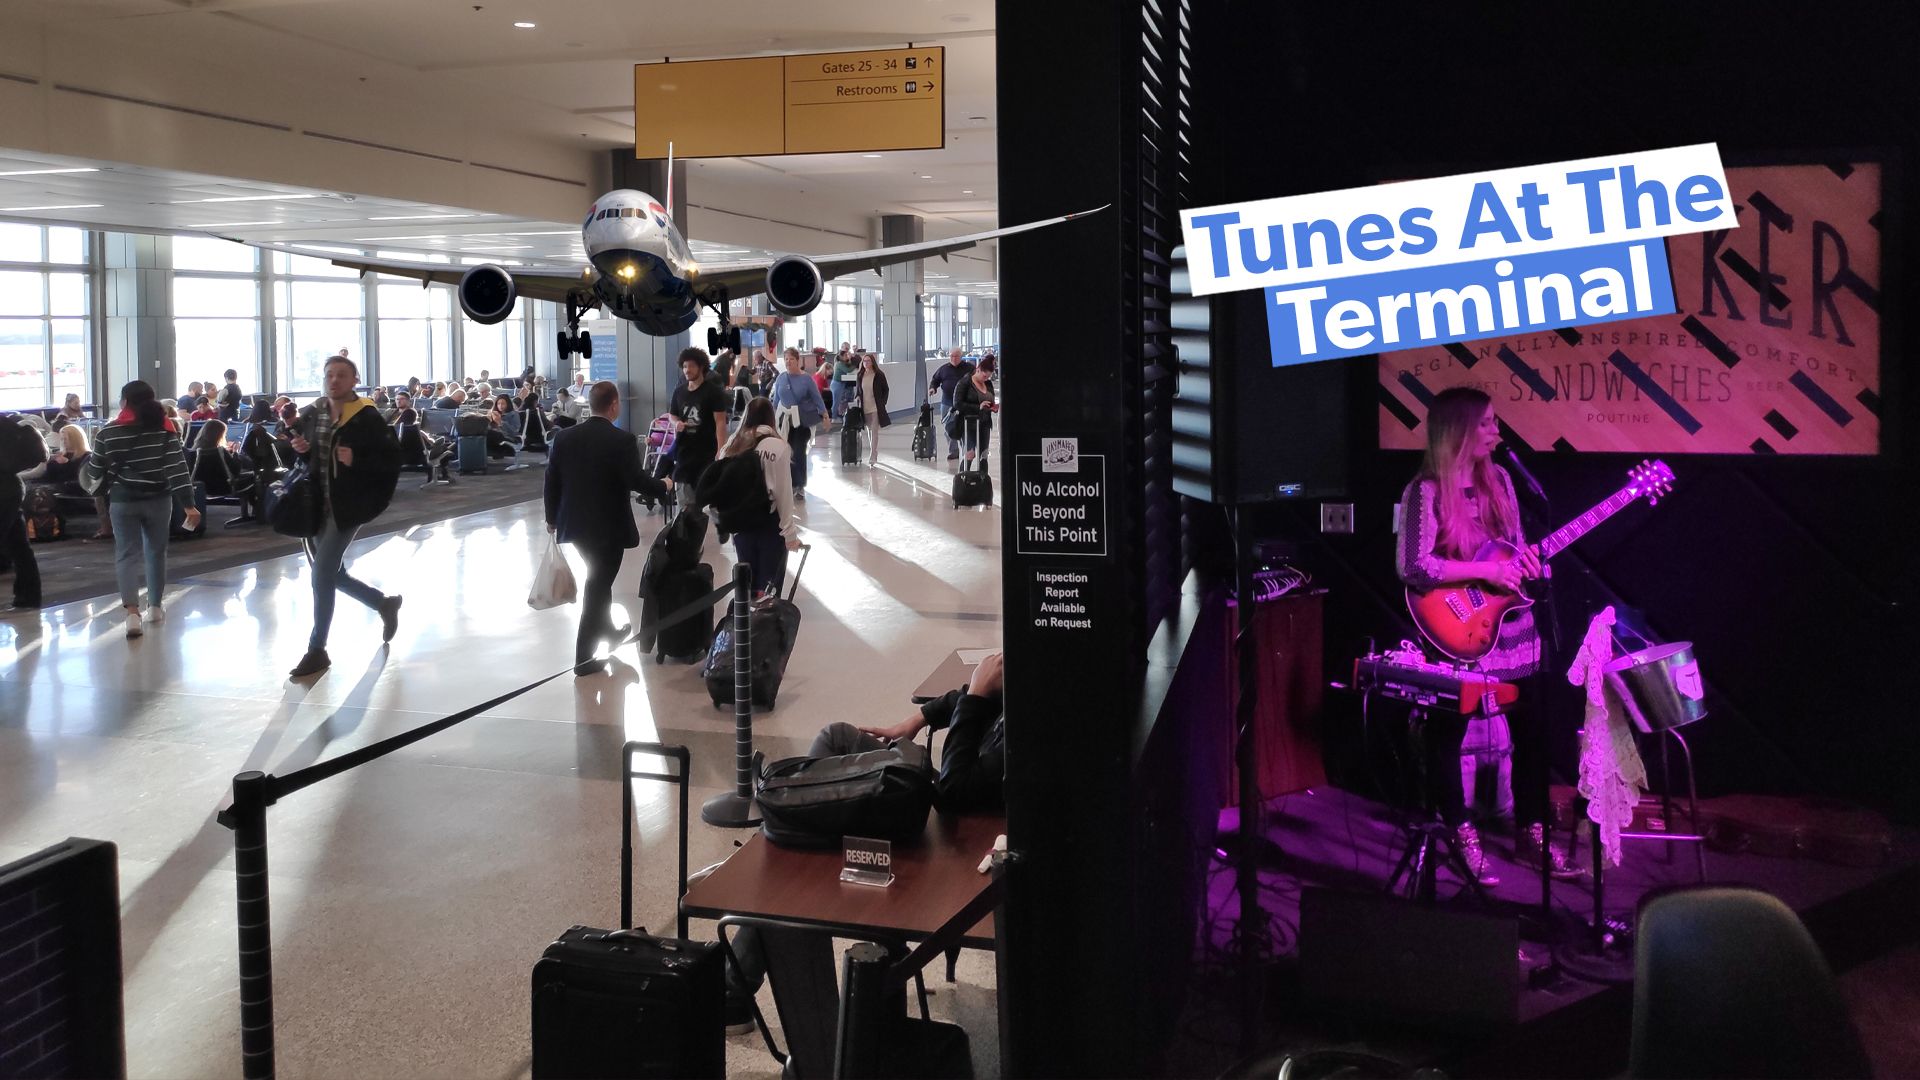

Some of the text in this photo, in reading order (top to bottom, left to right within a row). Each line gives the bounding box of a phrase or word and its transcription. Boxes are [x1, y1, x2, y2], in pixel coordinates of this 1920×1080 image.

[822, 62, 855, 73] Gates
[858, 60, 872, 72] 25
[883, 59, 897, 70] 34
[836, 84, 898, 96] Restrooms
[1666, 201, 1856, 347] KER
[1510, 361, 1731, 402] SNDWIHES
[1587, 412, 1650, 424] POUTINE
[1022, 481, 1099, 497] No Alcohol
[1032, 504, 1085, 522] Beyond
[1025, 526, 1098, 543] This Point
[1036, 571, 1088, 584] Inspection
[1045, 586, 1079, 599] Report
[1040, 602, 1086, 613] Available
[1034, 617, 1091, 630] on Request
[846, 849, 890, 866] RESERVED
